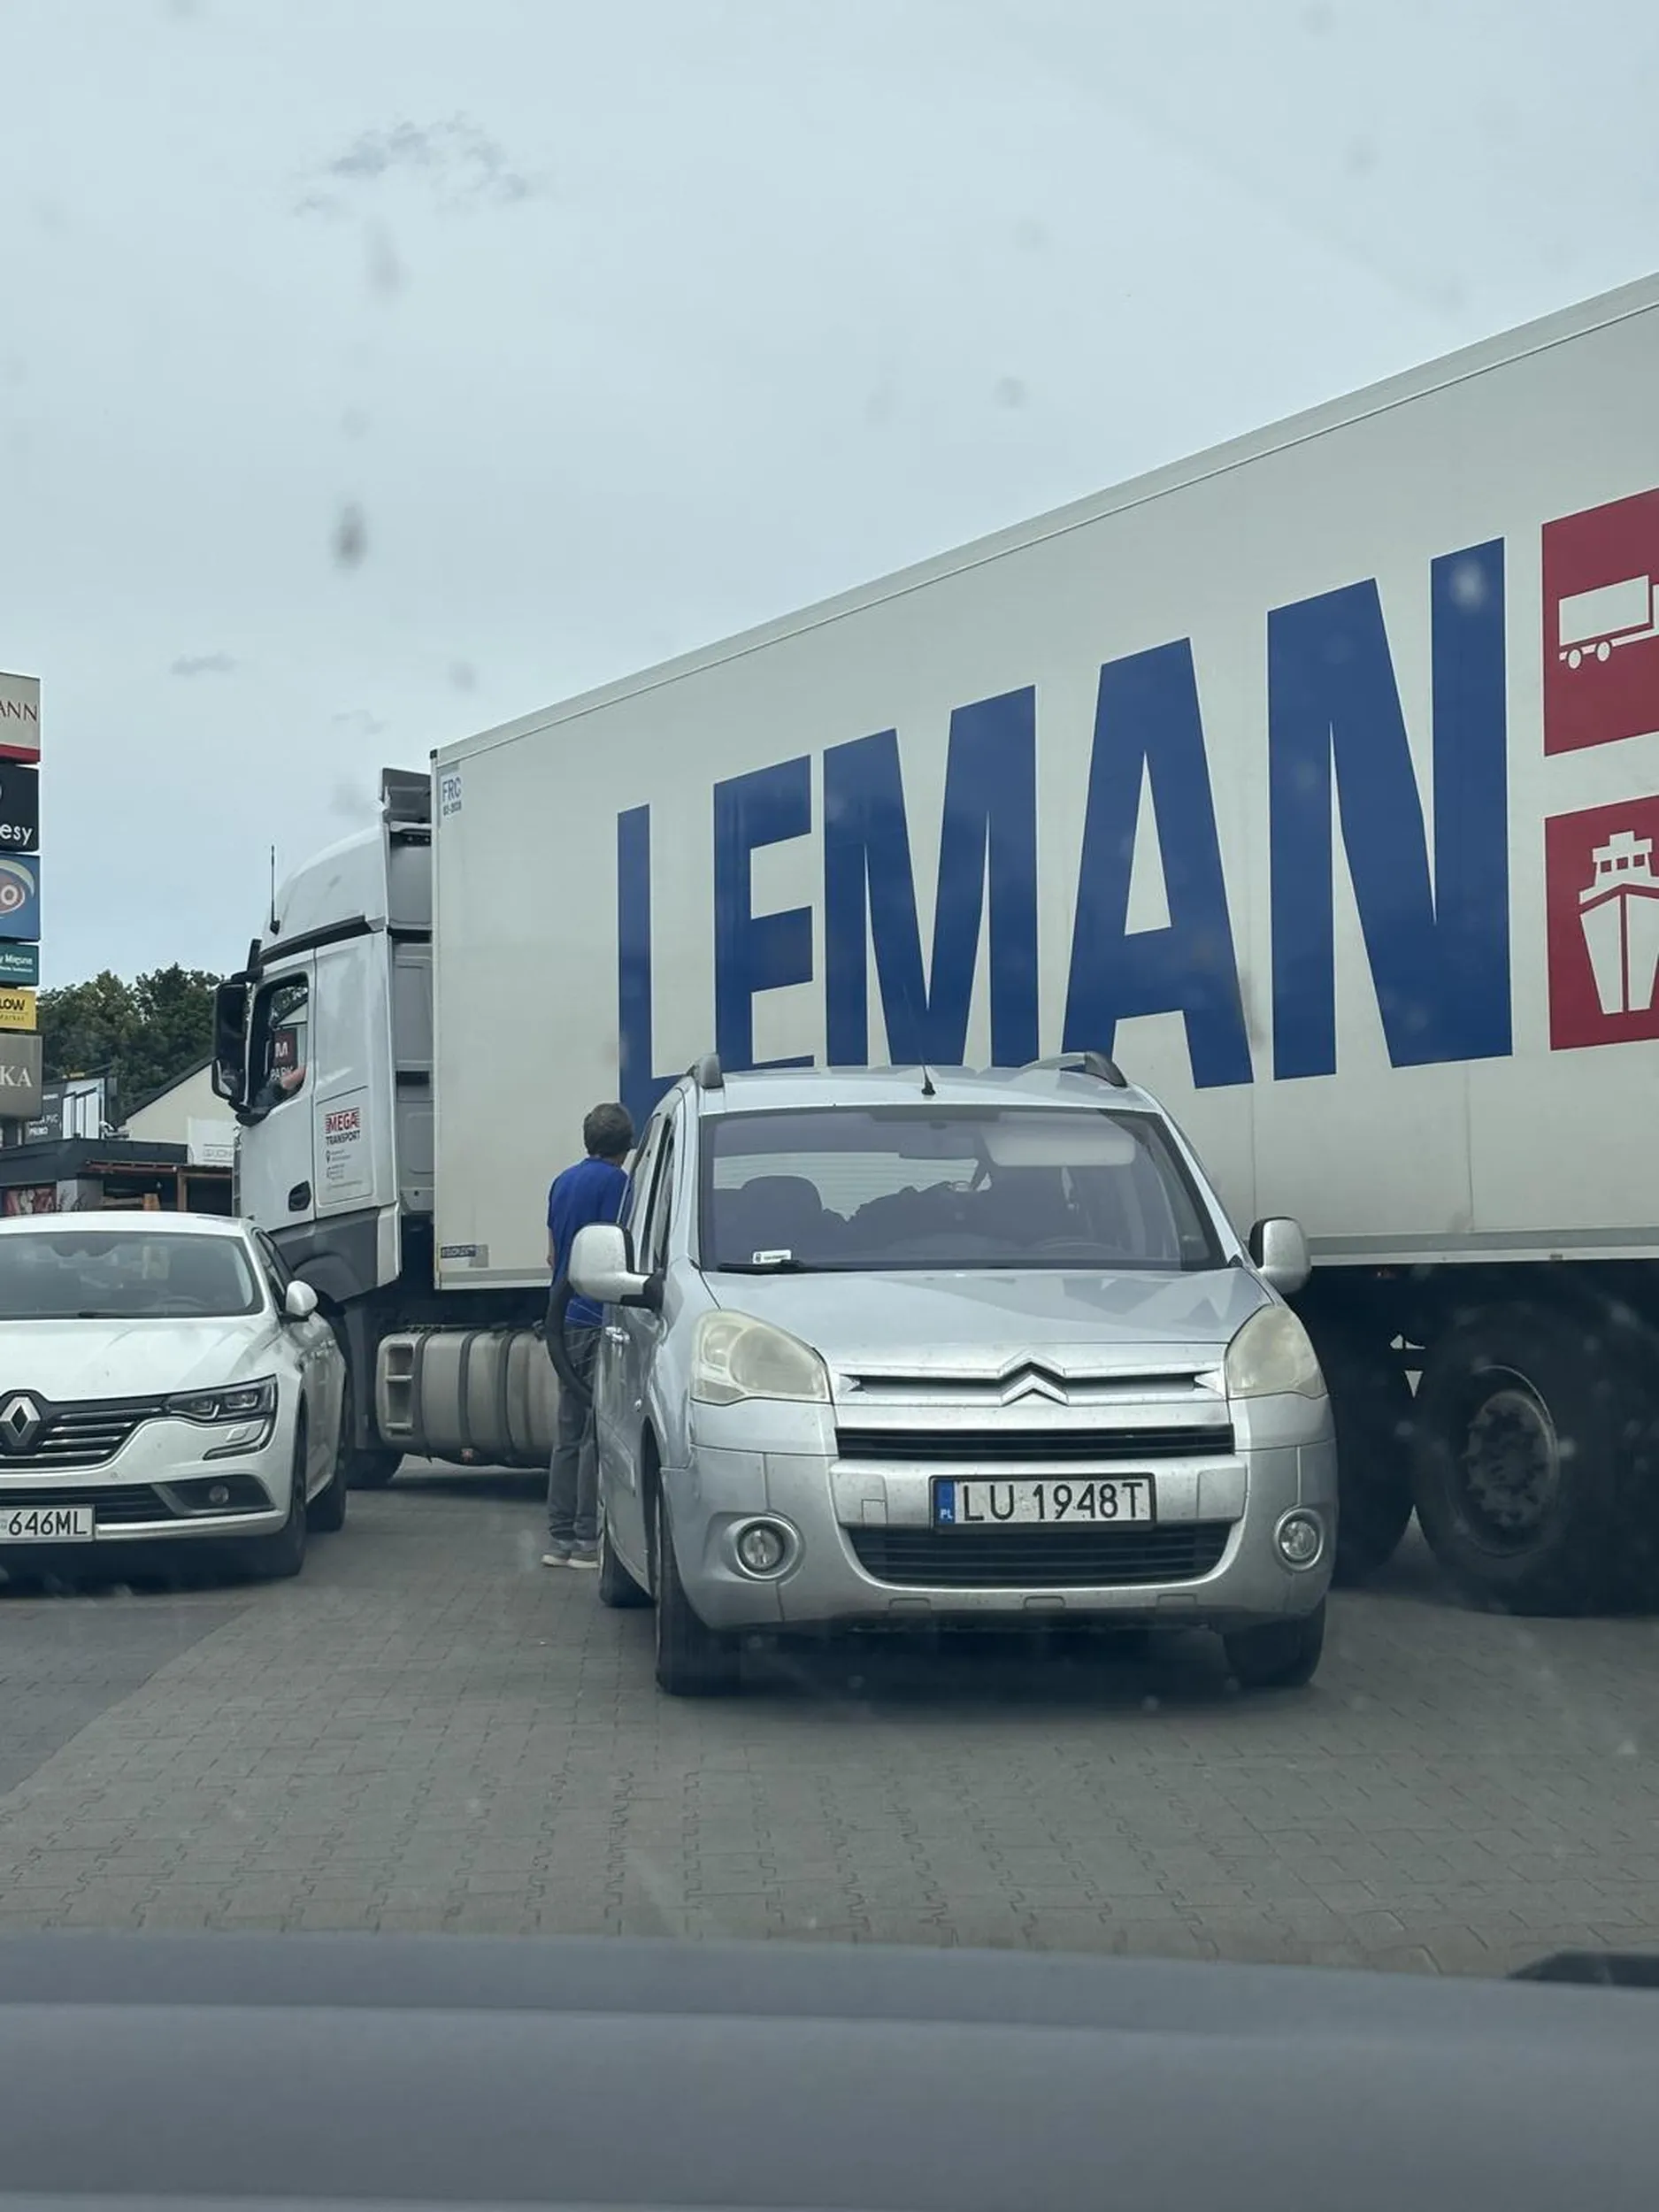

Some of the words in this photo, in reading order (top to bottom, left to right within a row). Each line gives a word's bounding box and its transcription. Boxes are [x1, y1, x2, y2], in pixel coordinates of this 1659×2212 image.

[442, 777, 461, 802] FRC
[0, 824, 32, 846] esy
[618, 537, 1512, 1150] LEMAN
[0, 1064, 32, 1087] KA
[326, 1110, 359, 1133] MEGA
[326, 1131, 360, 1145] TRANSPORT
[964, 1484, 1015, 1520] LU
[1033, 1482, 1142, 1520] 1948T
[9, 1511, 87, 1536] 646ML
[940, 1509, 953, 1519] PL
